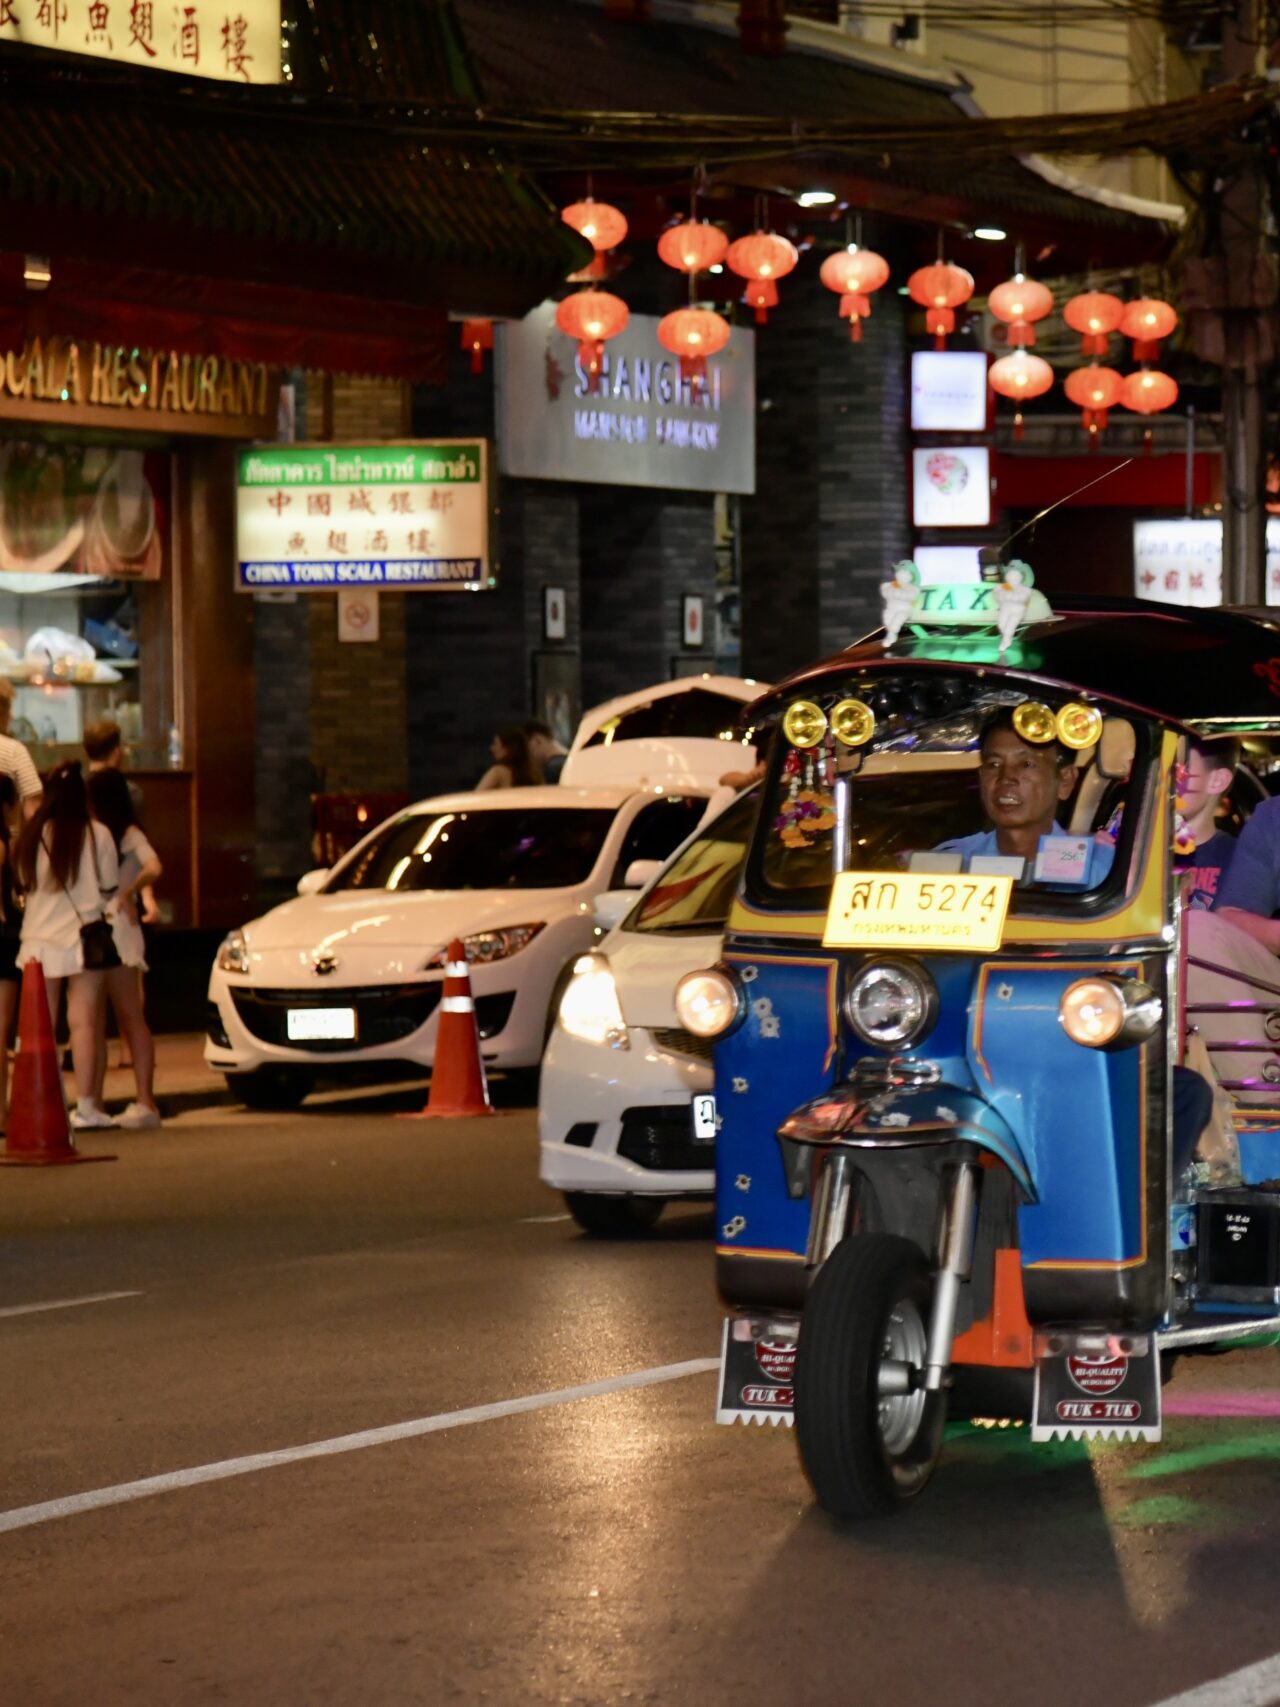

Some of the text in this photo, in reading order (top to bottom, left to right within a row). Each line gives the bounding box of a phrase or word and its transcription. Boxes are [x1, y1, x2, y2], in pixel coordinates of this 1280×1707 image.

[0, 336, 268, 416] CALA RESTAURANT
[292, 563, 336, 583] TOWN
[337, 563, 384, 583] SCALA
[920, 588, 1001, 612] TAX
[851, 880, 997, 913] สก 5274
[748, 1388, 778, 1402] TUK
[1062, 1403, 1093, 1417] TUK
[1104, 1403, 1135, 1417] TUK
